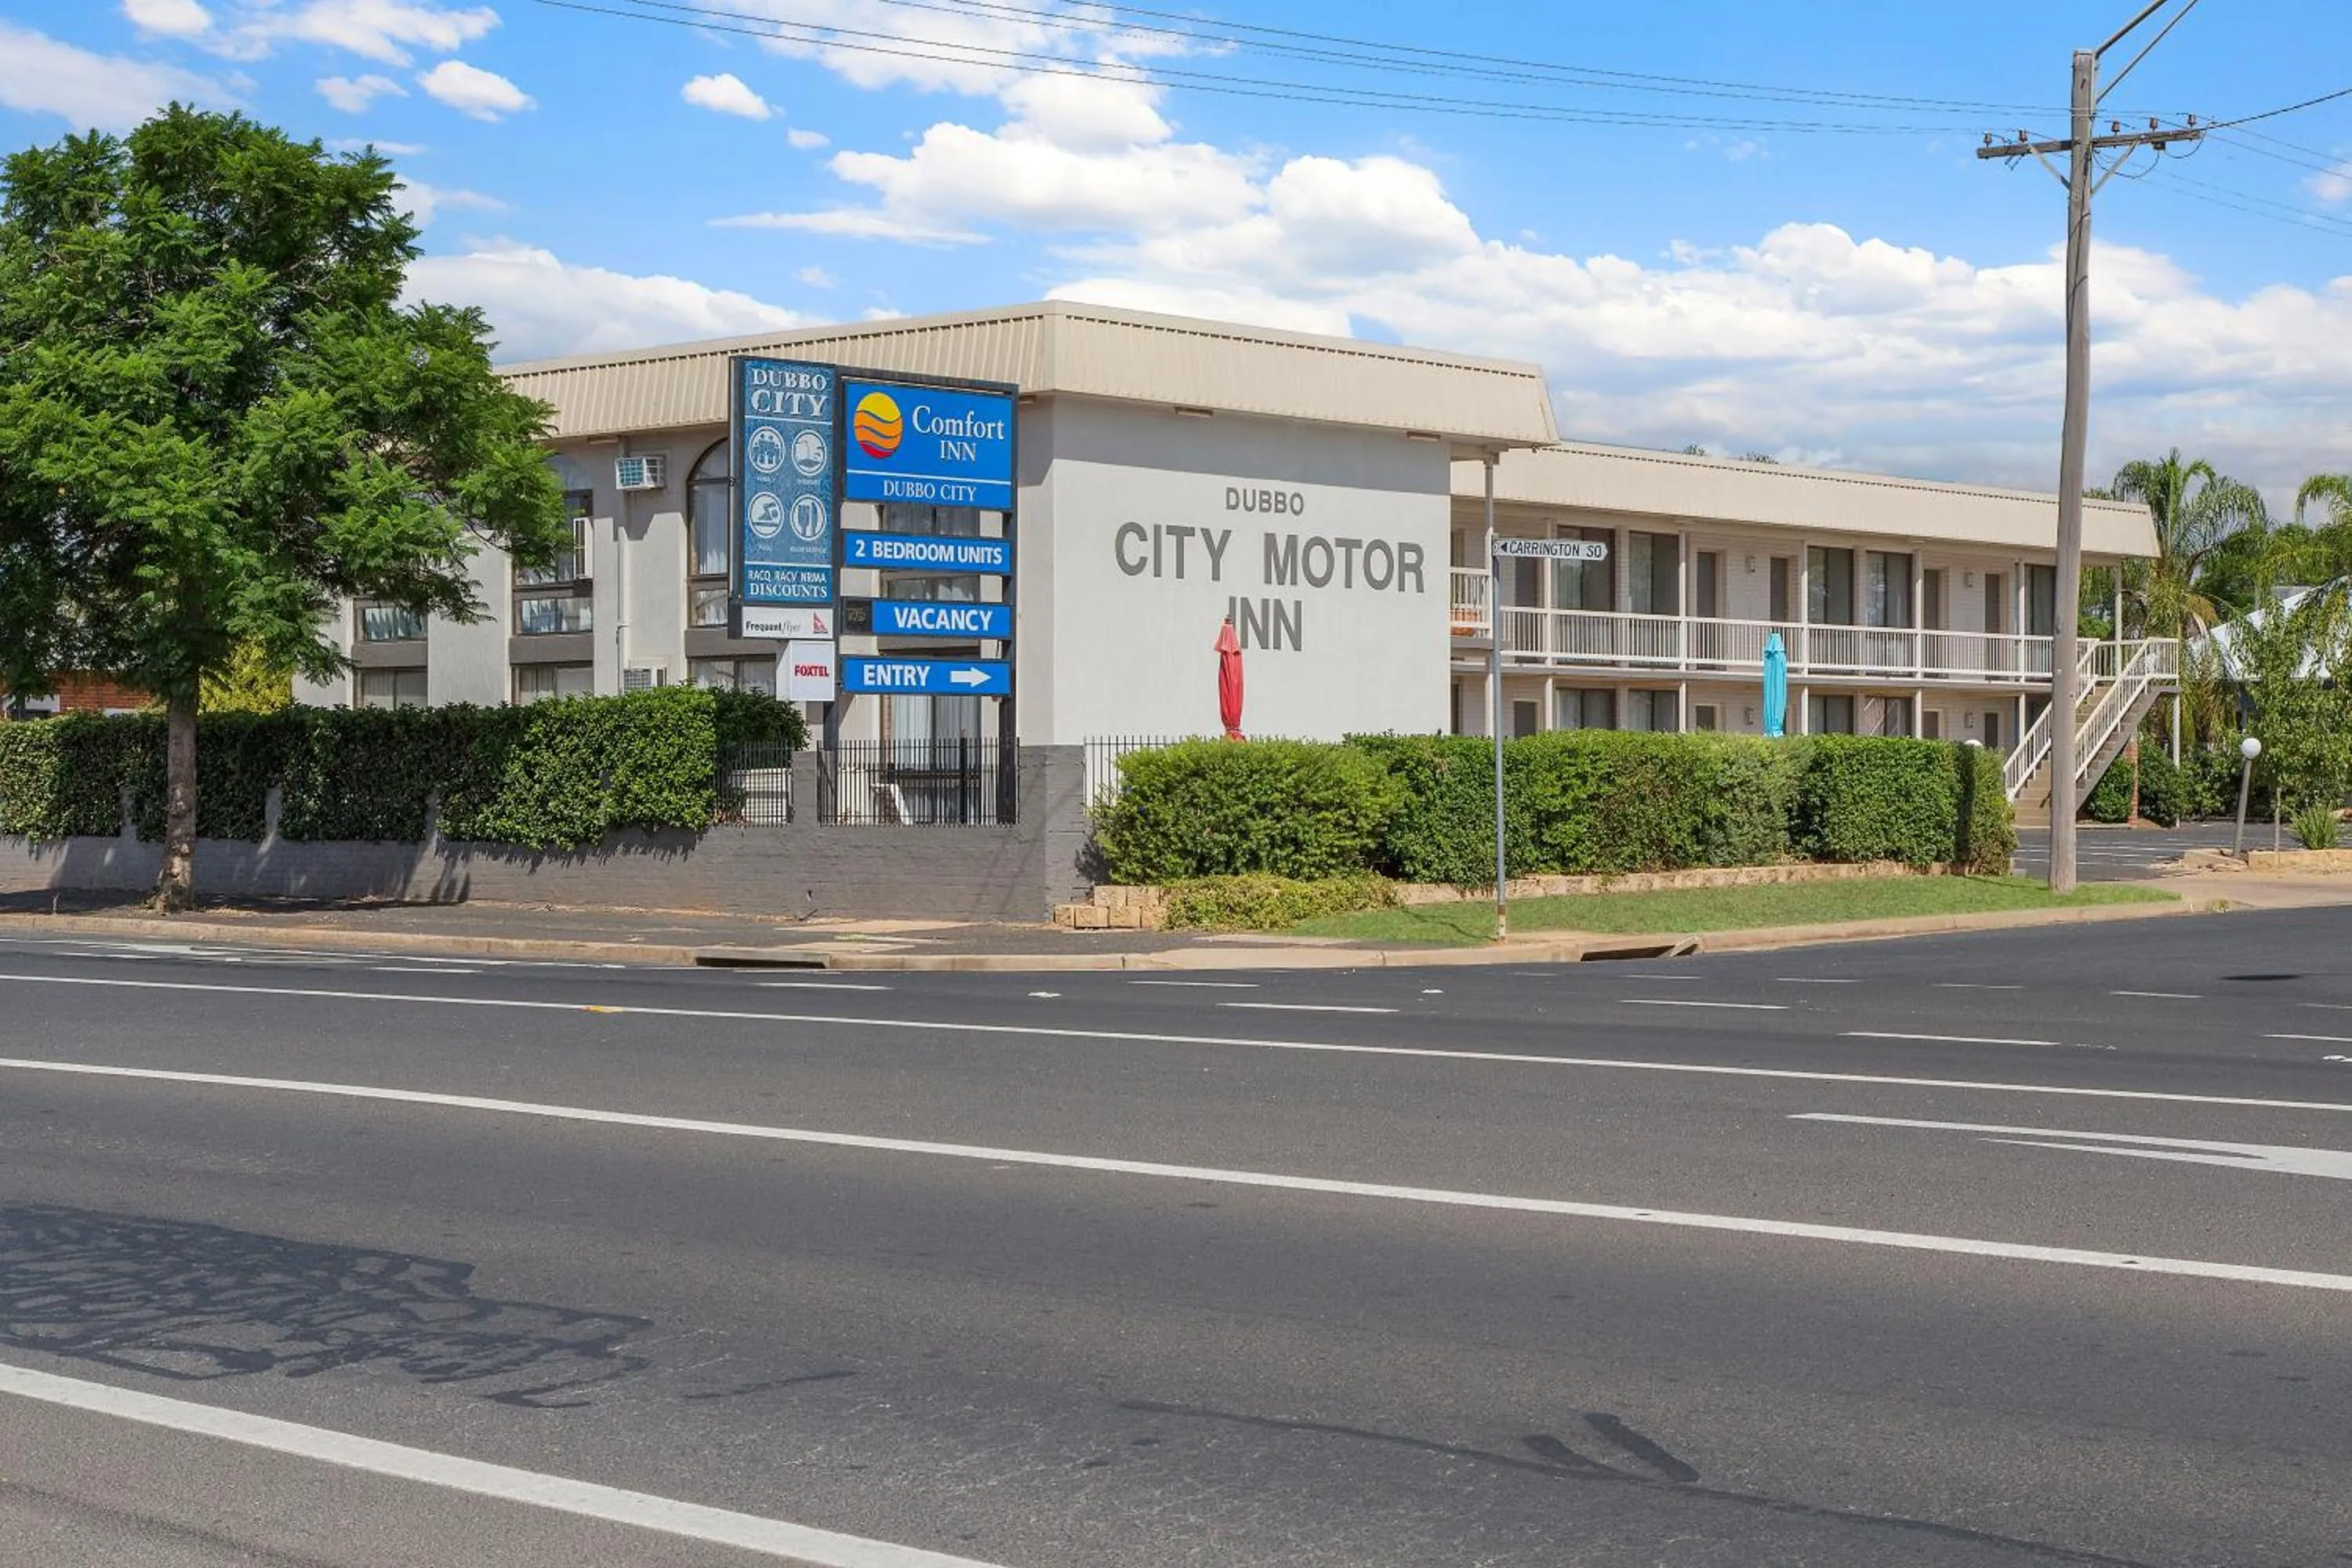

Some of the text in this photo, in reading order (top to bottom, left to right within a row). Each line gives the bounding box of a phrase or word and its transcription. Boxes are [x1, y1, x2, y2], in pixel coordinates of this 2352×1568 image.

[752, 368, 827, 390] DUBBO
[750, 390, 828, 417] CITY
[912, 405, 1004, 440] Comfort
[940, 441, 977, 461] INN
[884, 480, 978, 502] DUBBO CITY
[1225, 487, 1304, 516] DUBBO
[855, 540, 1003, 564] 2 BEDROOM UNITS
[1115, 521, 1425, 593] CITY MOTOR
[1509, 540, 1579, 557] CARRINGTON
[800, 572, 827, 583] NRMA
[750, 583, 827, 597] DISCOUNTS
[746, 621, 782, 632] Frequent
[894, 607, 993, 631] VACANCY
[794, 665, 829, 677] FOXTEL
[863, 664, 931, 687] ENTRY
